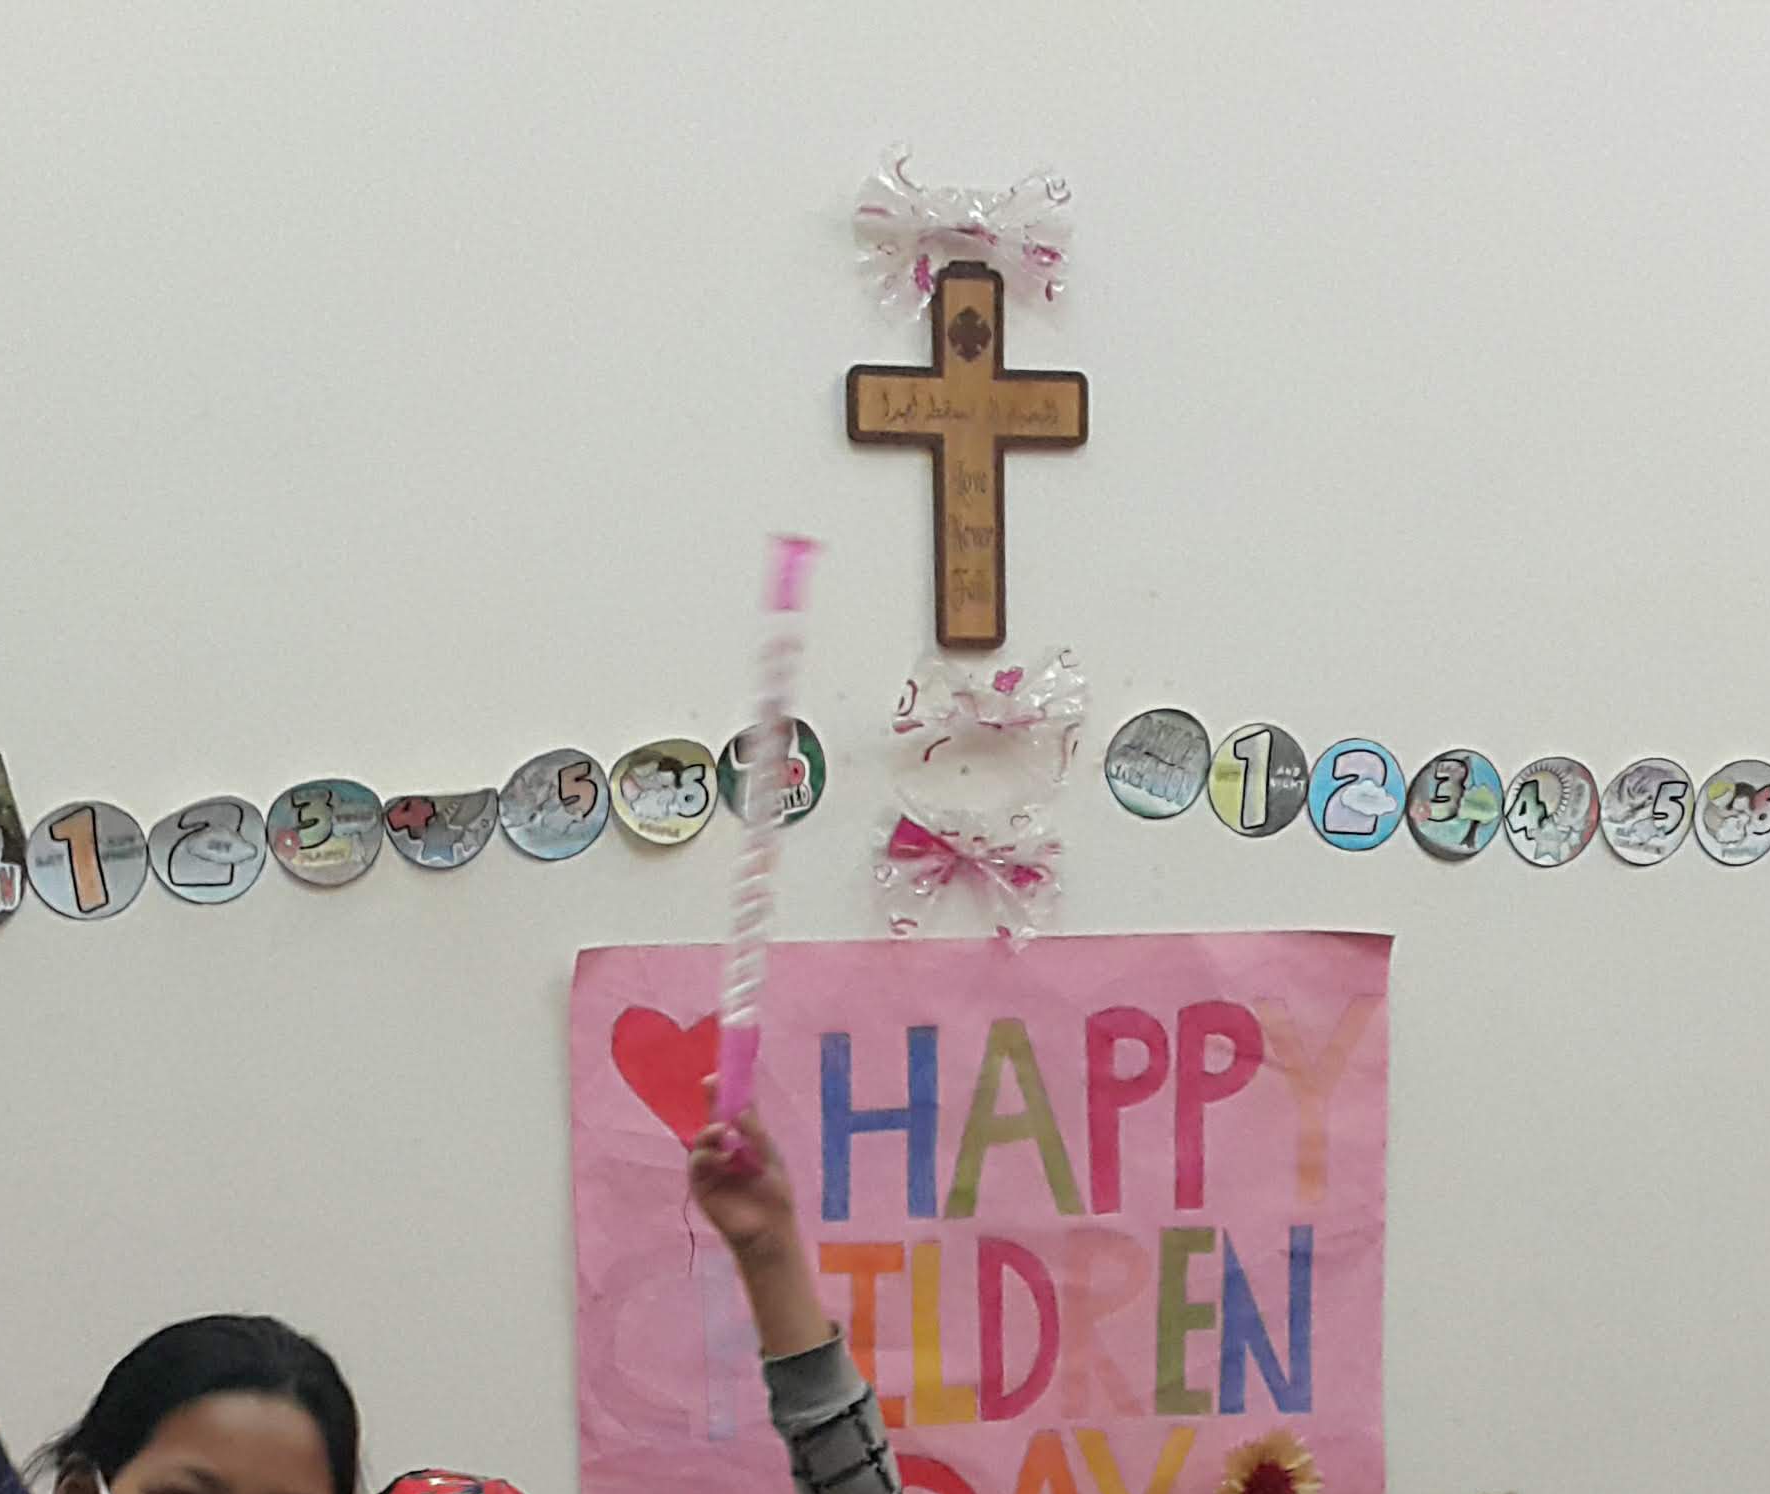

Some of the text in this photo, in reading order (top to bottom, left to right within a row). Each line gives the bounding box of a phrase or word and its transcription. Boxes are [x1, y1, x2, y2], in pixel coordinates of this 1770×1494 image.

[49, 805, 109, 914] 1
[168, 802, 243, 887] 2
[292, 788, 333, 850] 3
[558, 762, 598, 818] 5
[673, 763, 709, 818] 6
[1233, 729, 1274, 830] 1
[1323, 749, 1388, 835] 2
[1428, 758, 1469, 822] 3
[1505, 780, 1549, 841] 4
[1652, 780, 1689, 837] 5
[820, 999, 1381, 1221] HAPPY
